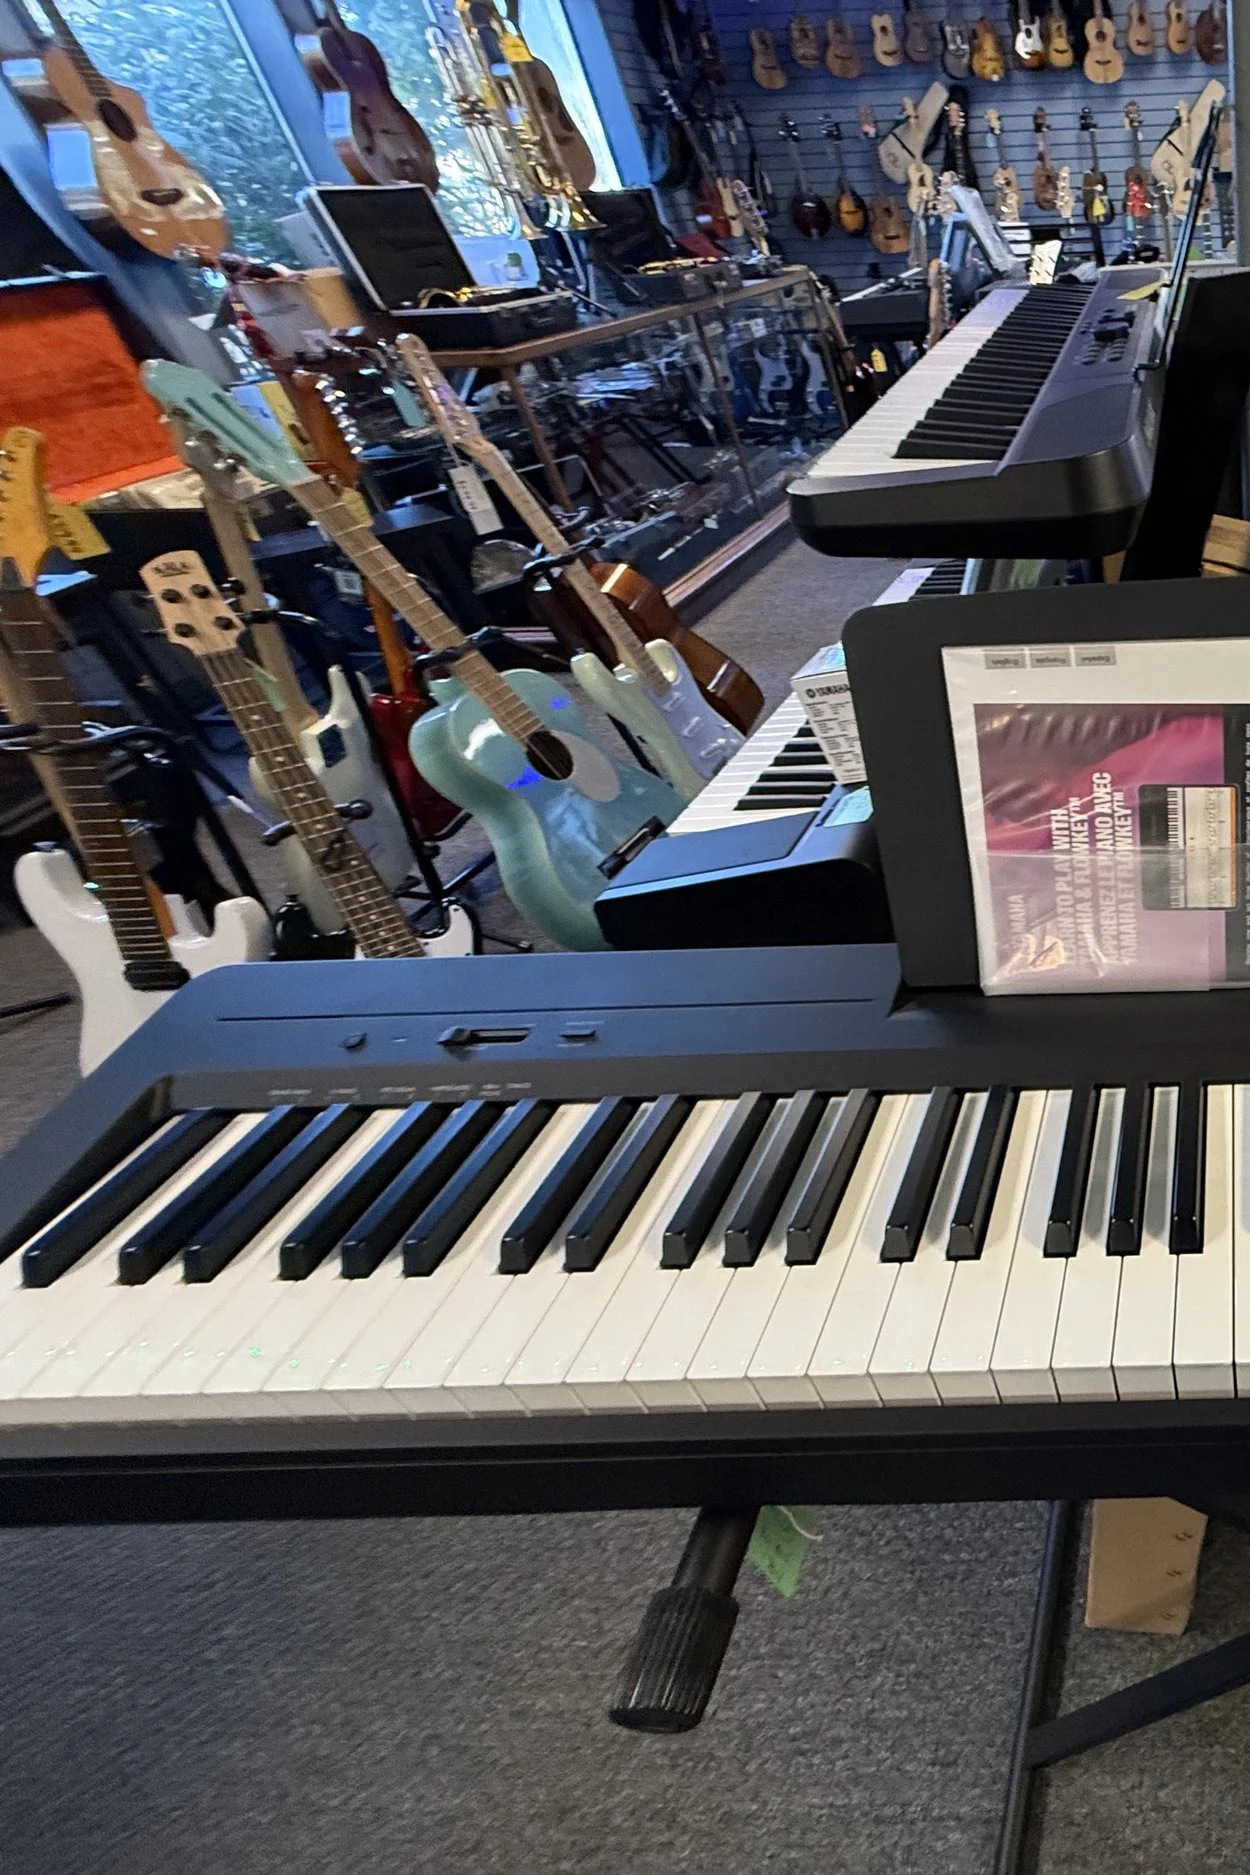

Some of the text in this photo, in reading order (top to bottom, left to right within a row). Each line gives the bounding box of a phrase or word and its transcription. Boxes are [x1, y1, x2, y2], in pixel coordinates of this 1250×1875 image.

[1092, 772, 1113, 813] AVEC
[1051, 809, 1070, 850] WITH
[1095, 815, 1114, 865] PIANO
[1054, 852, 1073, 892] PLAY
[1096, 869, 1114, 885] LE
[1056, 894, 1074, 913] TO
[1075, 887, 1091, 899] &
[1116, 881, 1135, 898] ET
